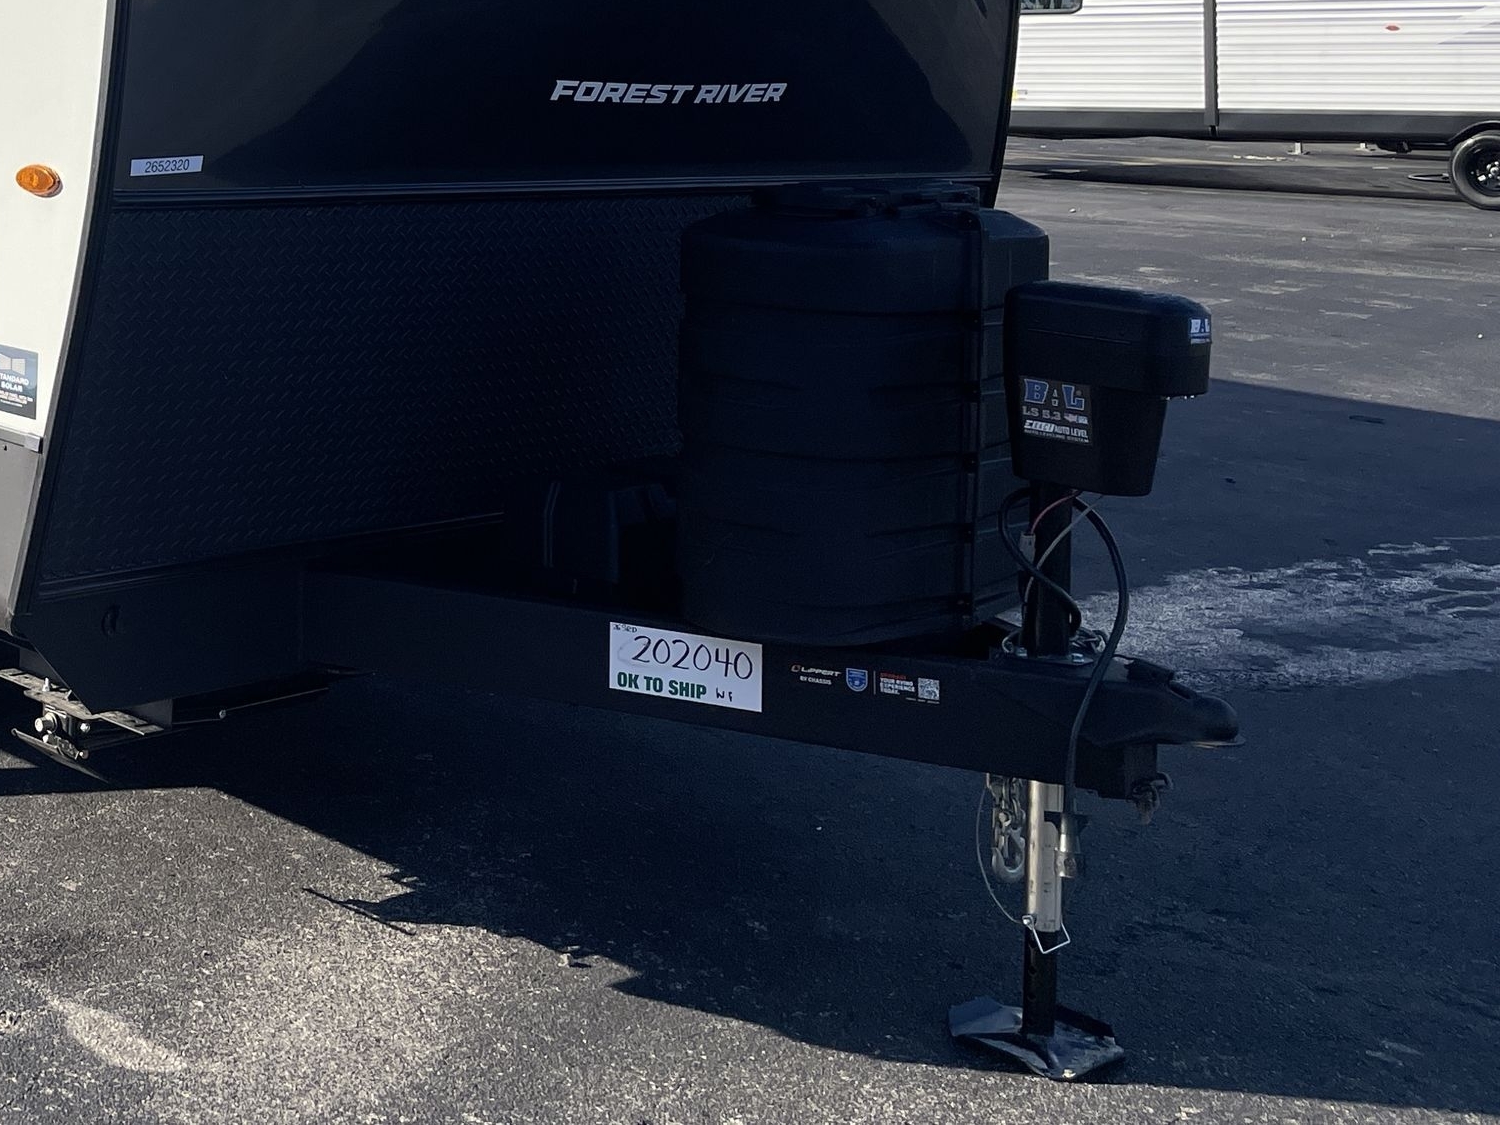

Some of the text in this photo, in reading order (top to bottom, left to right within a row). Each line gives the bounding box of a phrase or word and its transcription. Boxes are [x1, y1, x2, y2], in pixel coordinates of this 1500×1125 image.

[549, 79, 788, 105] FOREST RIVER
[144, 158, 190, 174] 2652320
[0, 380, 23, 393] SOLAR
[1022, 405, 1040, 417] LS
[631, 635, 753, 680] 202040
[617, 671, 708, 700] OK TO SHIP
